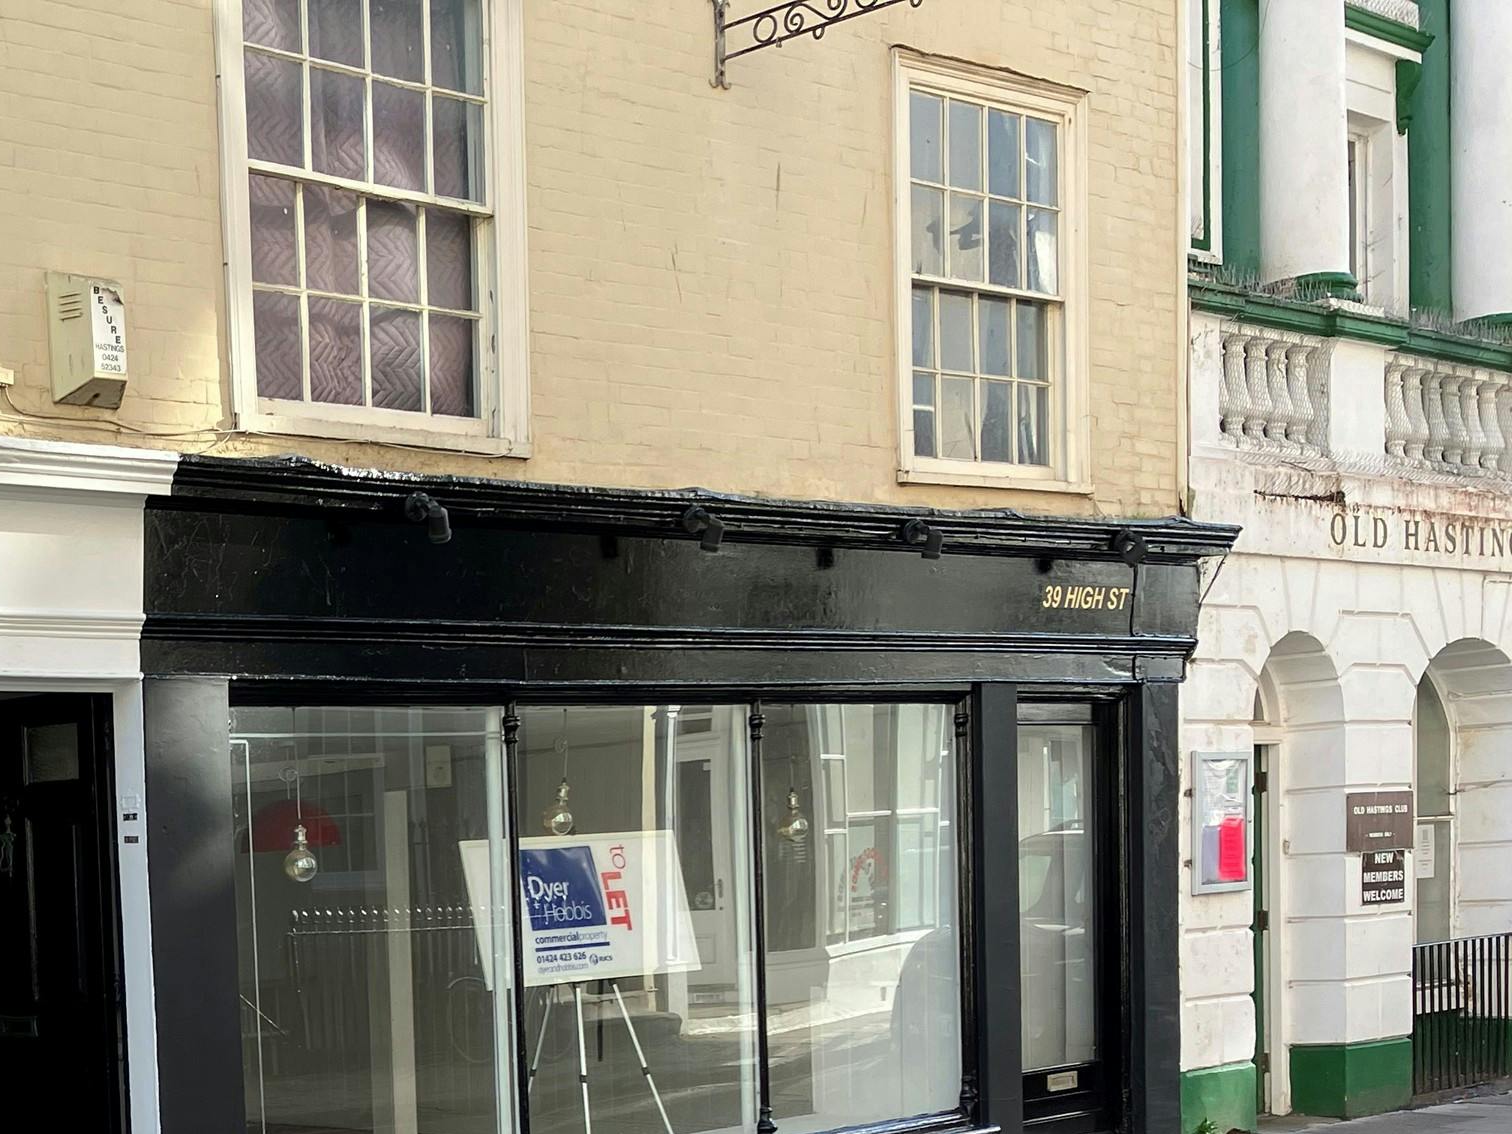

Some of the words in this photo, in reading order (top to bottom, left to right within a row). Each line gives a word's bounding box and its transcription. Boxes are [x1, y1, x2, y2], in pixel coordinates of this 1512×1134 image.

[96, 343, 125, 353] HASTINGS
[1330, 513, 1388, 549] OLD
[1404, 519, 1512, 560] HASTIN
[1043, 586, 1062, 608] 39
[1064, 586, 1106, 609] HIGH
[1108, 588, 1129, 610] ST
[1353, 805, 1365, 815] OLD
[1366, 804, 1393, 815] HASTINGS
[1394, 804, 1408, 814] CLUB
[1374, 852, 1394, 864] NEW
[1363, 870, 1404, 883] MEMBERS
[527, 876, 569, 903] Dyer
[1363, 888, 1404, 902] WELCOME
[600, 871, 633, 931] LET
[544, 900, 593, 923] Hobbis
[536, 953, 558, 964] 01424
[559, 952, 572, 962] 423
